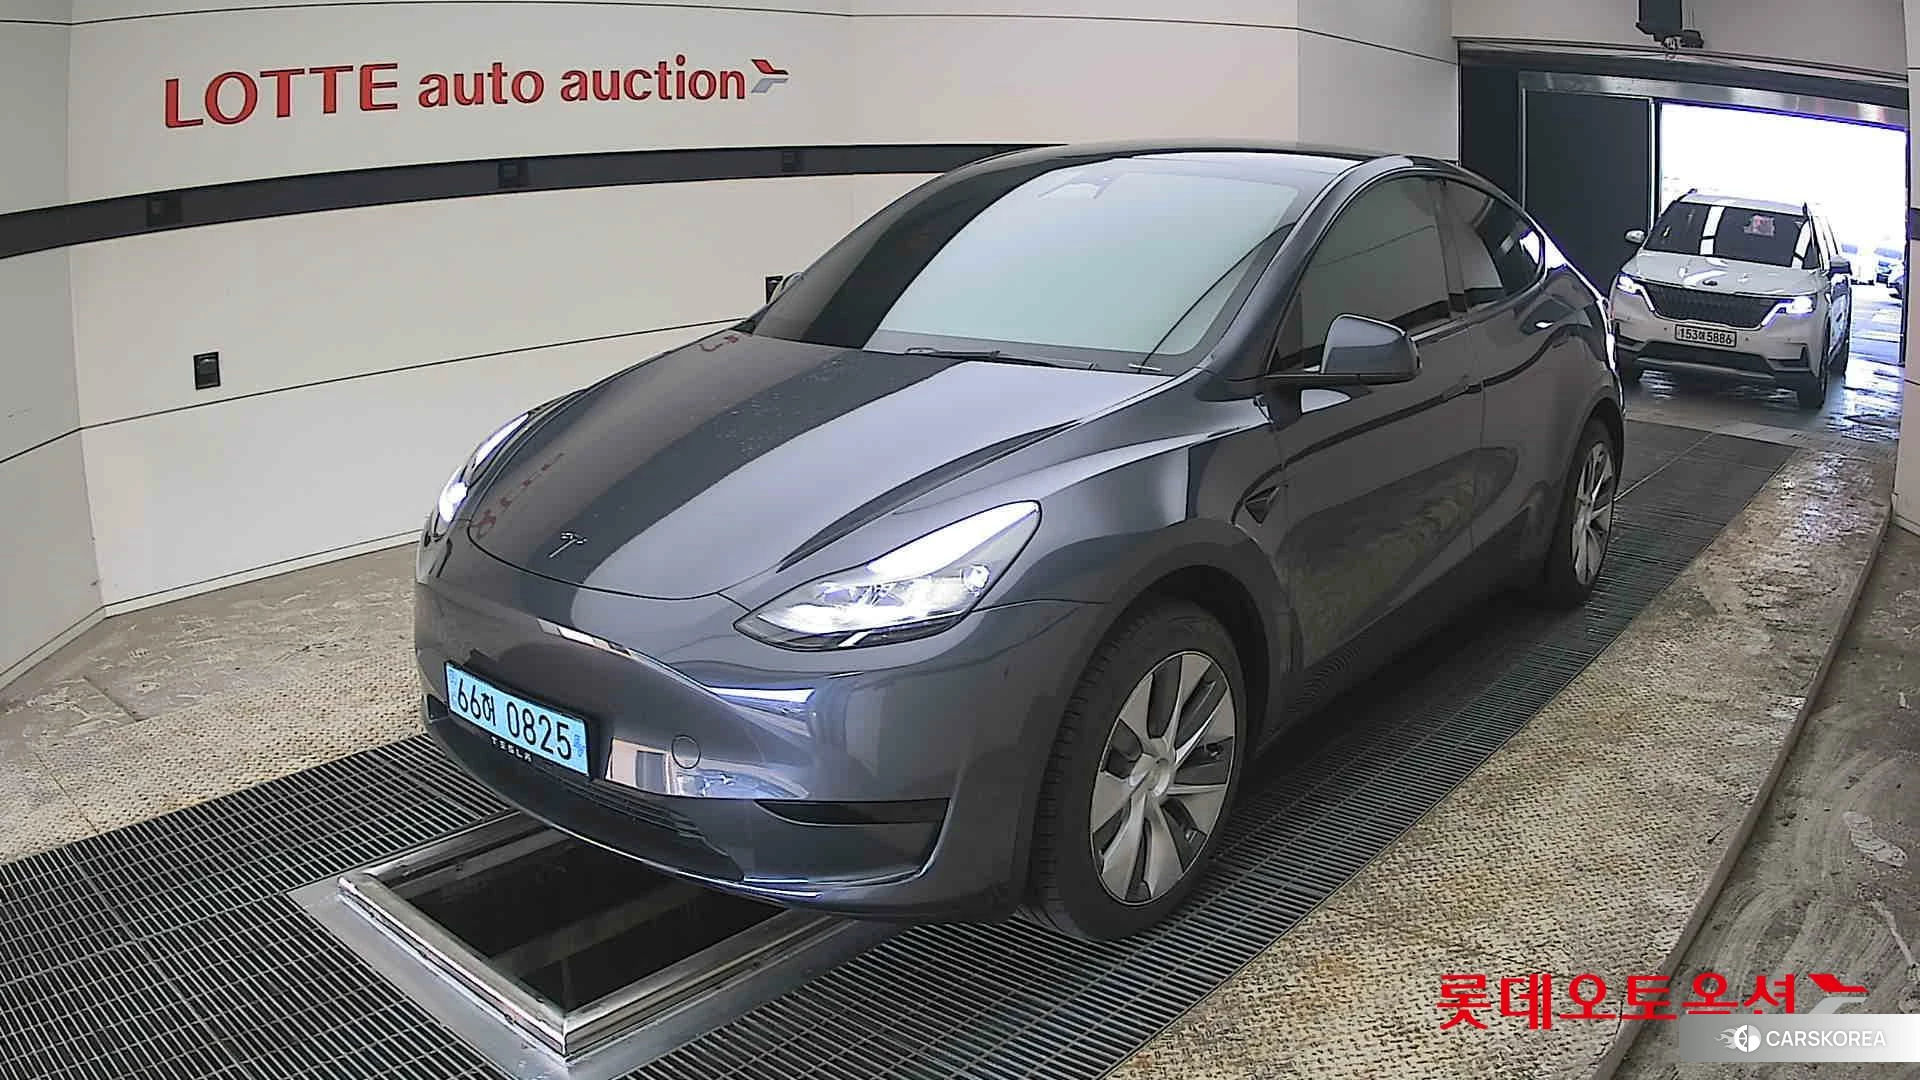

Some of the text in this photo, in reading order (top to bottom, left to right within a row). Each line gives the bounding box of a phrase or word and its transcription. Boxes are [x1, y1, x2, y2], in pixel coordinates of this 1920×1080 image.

[164, 54, 747, 128] LOTTE auto auction
[457, 678, 497, 727] 66허
[506, 701, 572, 760] 0825
[490, 735, 533, 763] TESLA
